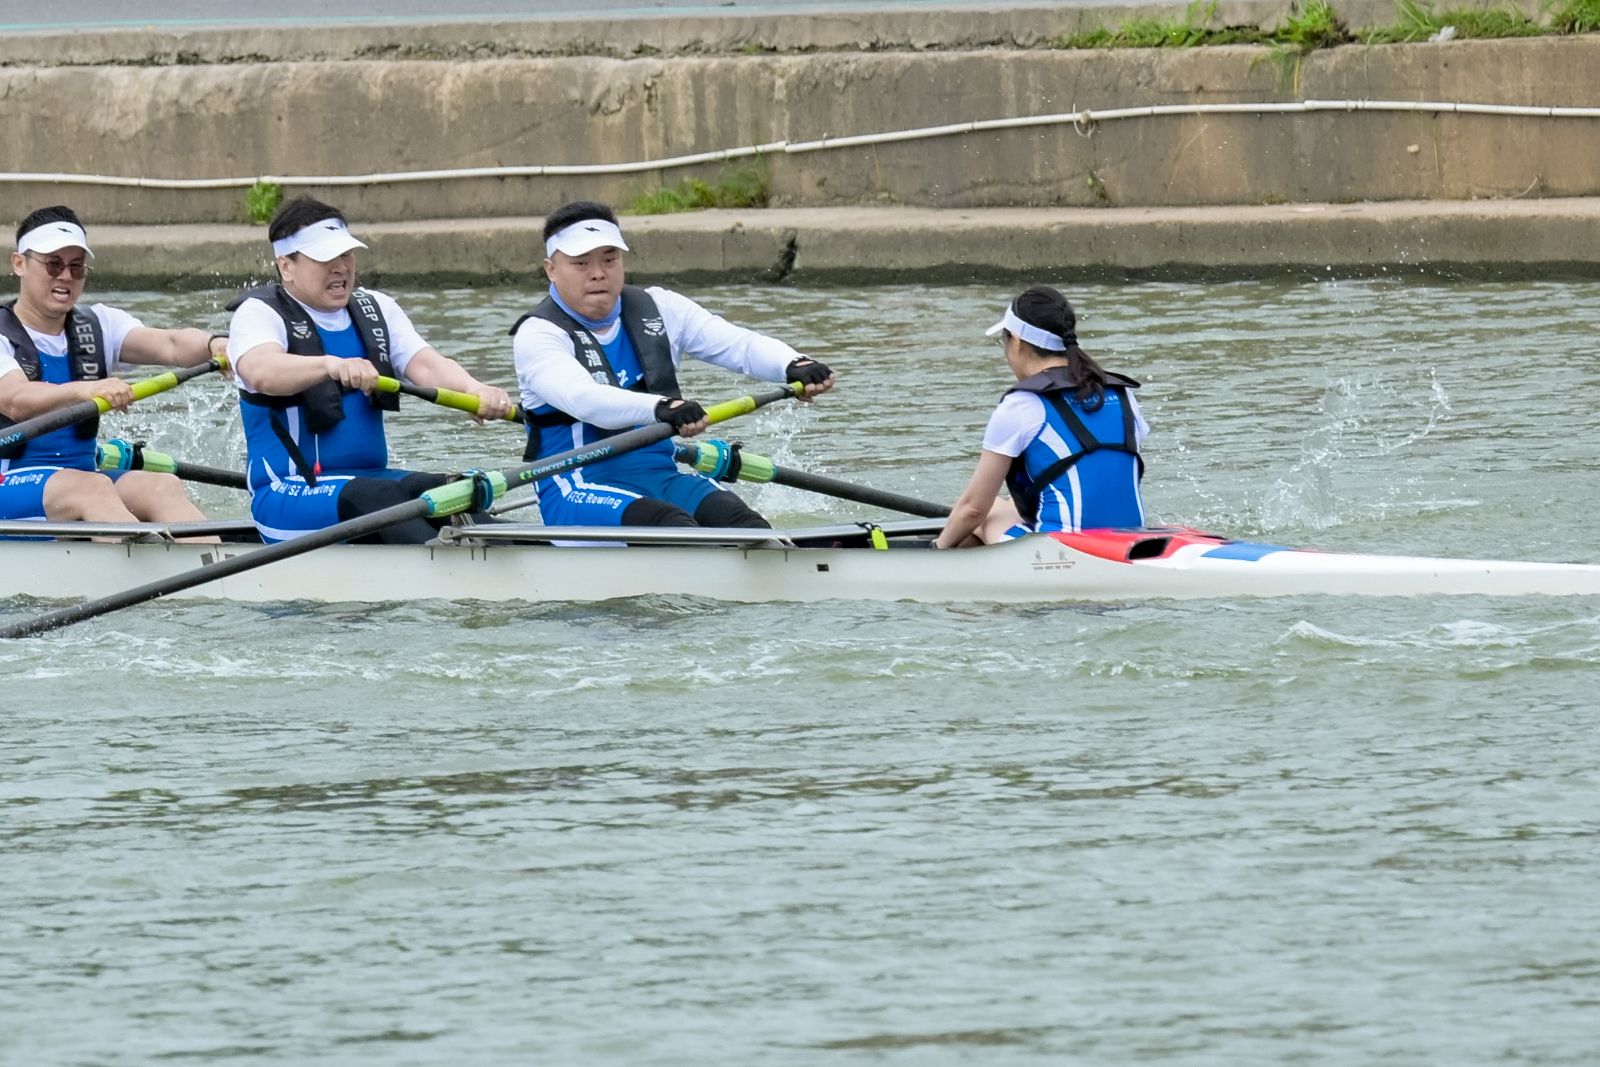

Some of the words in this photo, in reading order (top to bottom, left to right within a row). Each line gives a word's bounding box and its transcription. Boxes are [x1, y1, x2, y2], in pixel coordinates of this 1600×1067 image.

[72, 314, 97, 354] DEEP
[352, 291, 379, 322] DEEP
[372, 328, 389, 363] DIVE
[82, 362, 99, 380] DI
[532, 460, 566, 476] concept
[576, 446, 611, 463] SKINNY
[8, 473, 44, 486] Rowing
[302, 484, 337, 497] Rowing
[585, 493, 623, 510] Rowing
